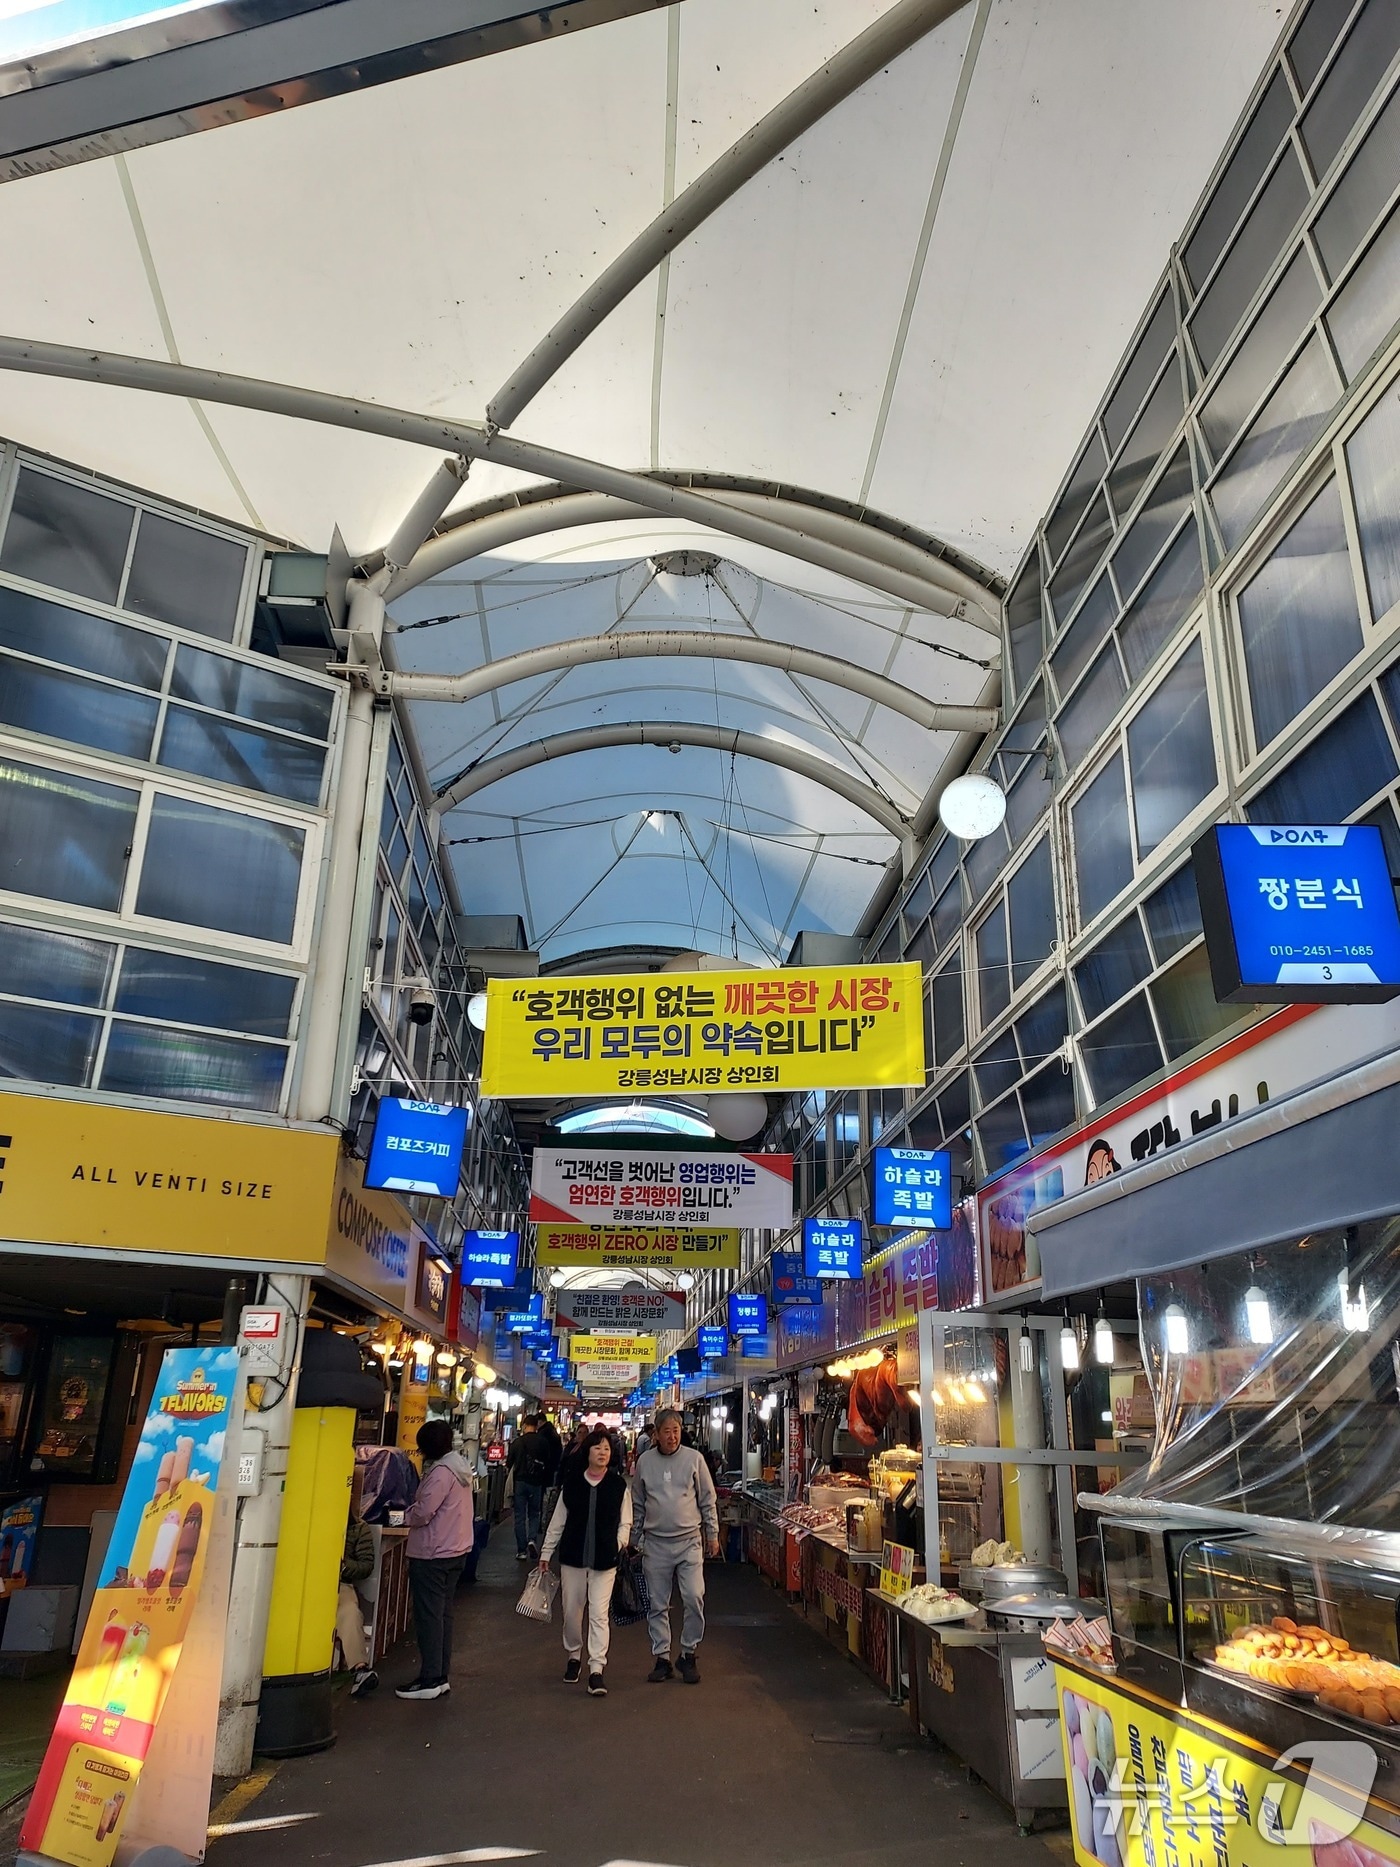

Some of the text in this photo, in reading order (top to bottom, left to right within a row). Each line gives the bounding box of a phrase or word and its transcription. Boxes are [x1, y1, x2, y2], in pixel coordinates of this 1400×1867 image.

[1258, 878, 1364, 911] 짱분식
[1270, 945, 1374, 956] 010-2451-1685
[1322, 966, 1333, 980] 3
[511, 975, 900, 1022] “호객행위 없는 깨끗한 시장,
[531, 1015, 876, 1062] 우리 모두의 약속입니다”
[617, 1065, 780, 1087] 강릉성남시장 상인회
[386, 1136, 451, 1158] 컴포즈커피
[554, 1158, 756, 1185] “고객선을 벗어난 영업행위는
[884, 1166, 942, 1186] 하슬라
[71, 1165, 273, 1199] ALL VENTI SIZE
[408, 1181, 416, 1190] 2
[568, 1184, 741, 1209] 엄연한 호객행위입니다.”
[893, 1189, 934, 1211] 족발
[337, 1187, 383, 1262] COMPOSE
[612, 1209, 710, 1223] 강릉성남시장 상인회
[910, 1217, 917, 1225] 5
[547, 1233, 729, 1252] 호객행위 ZERO 시장 만들기”
[811, 1232, 856, 1247] 하슬라
[602, 1255, 673, 1265] 강릉성남시장 상인회
[817, 1250, 850, 1266] 족발
[902, 1232, 939, 1314] 족발
[621, 1295, 646, 1307] 호객은
[647, 1295, 665, 1307] NO!
[572, 1306, 589, 1318] 함께
[590, 1306, 614, 1319] 만드는
[176, 1380, 210, 1391] Summer
[167, 1392, 228, 1413] FLAVORS!
